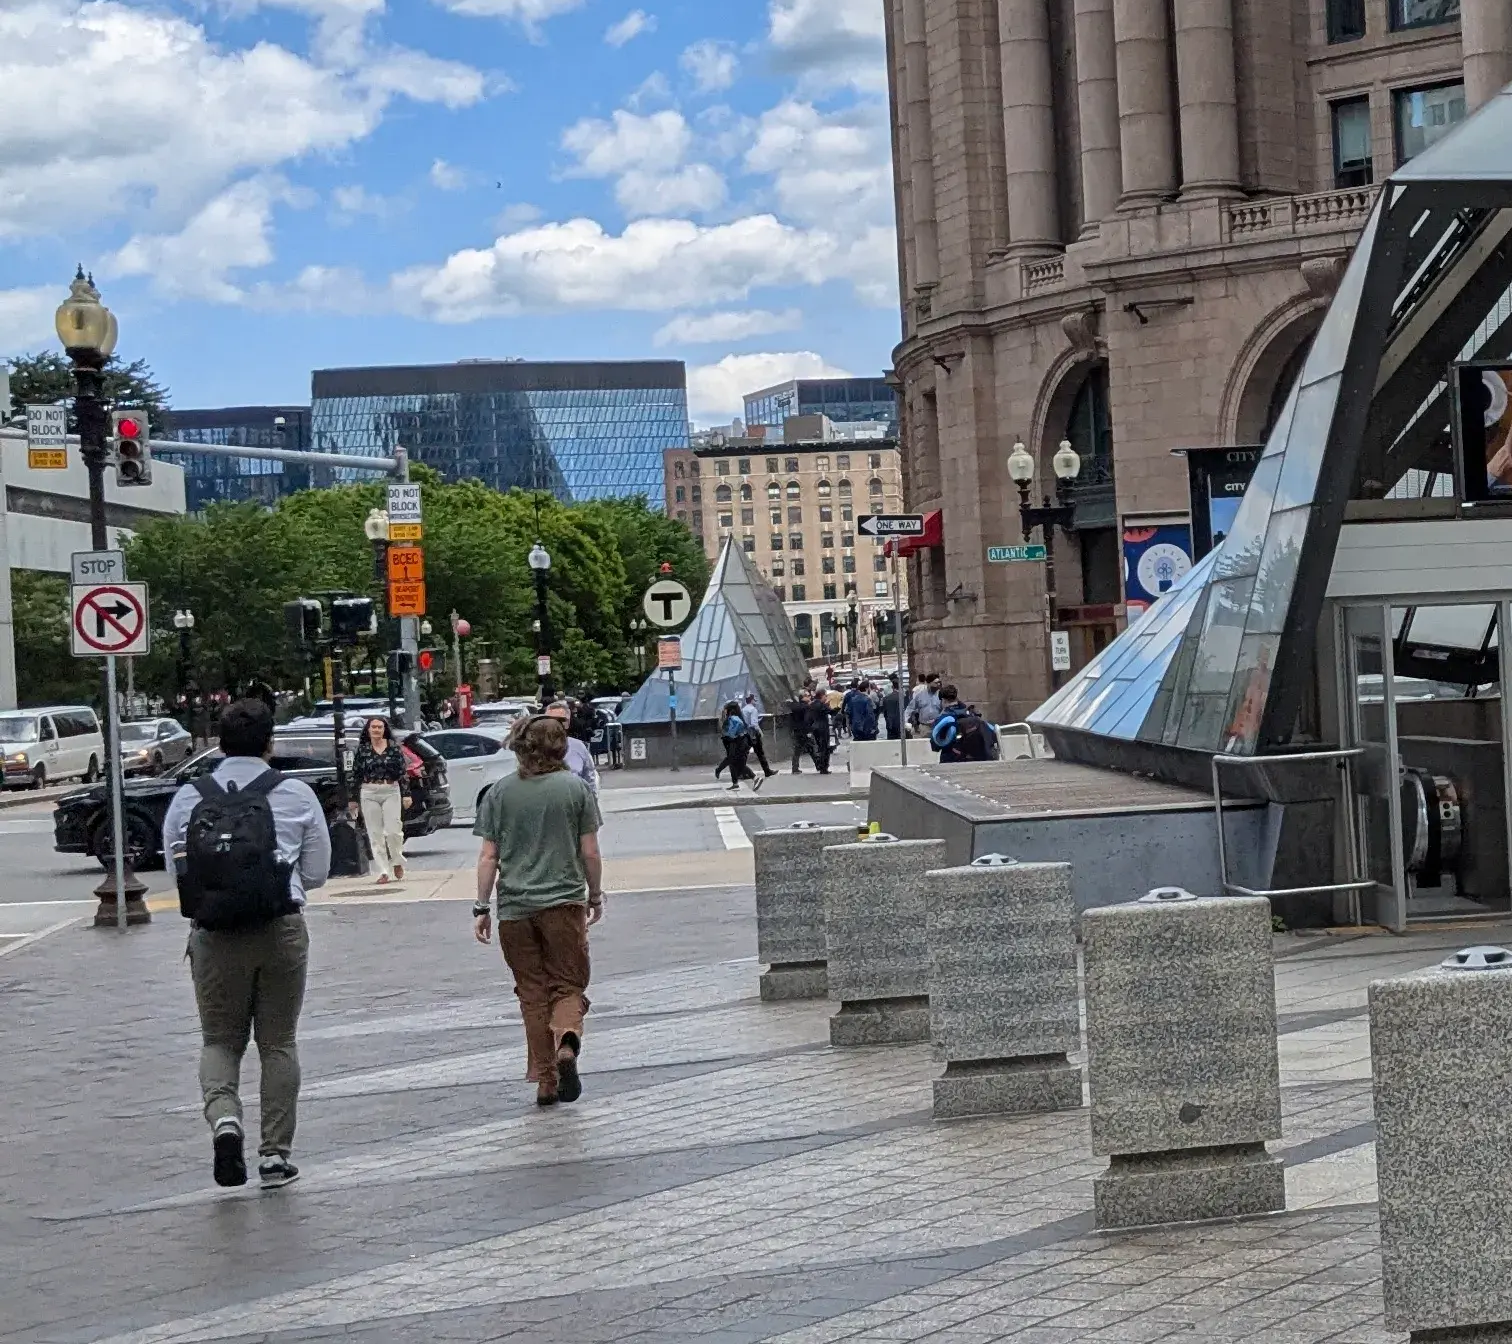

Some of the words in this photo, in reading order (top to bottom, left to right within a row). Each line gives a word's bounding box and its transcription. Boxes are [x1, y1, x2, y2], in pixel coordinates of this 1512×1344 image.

[29, 410, 42, 420] DO
[45, 410, 64, 421] NOT
[31, 425, 62, 435] BLOCK
[1226, 451, 1257, 462] CITY
[1225, 483, 1246, 491] CITY
[389, 488, 400, 498] DO
[403, 488, 419, 498] NOT
[391, 502, 418, 511] BLOCK
[876, 521, 895, 530] ONE
[898, 520, 917, 529] WAY
[991, 546, 1029, 559] ATLANTIC
[392, 553, 419, 565] BCEC
[80, 559, 116, 574] STOP
[651, 592, 684, 621] T
